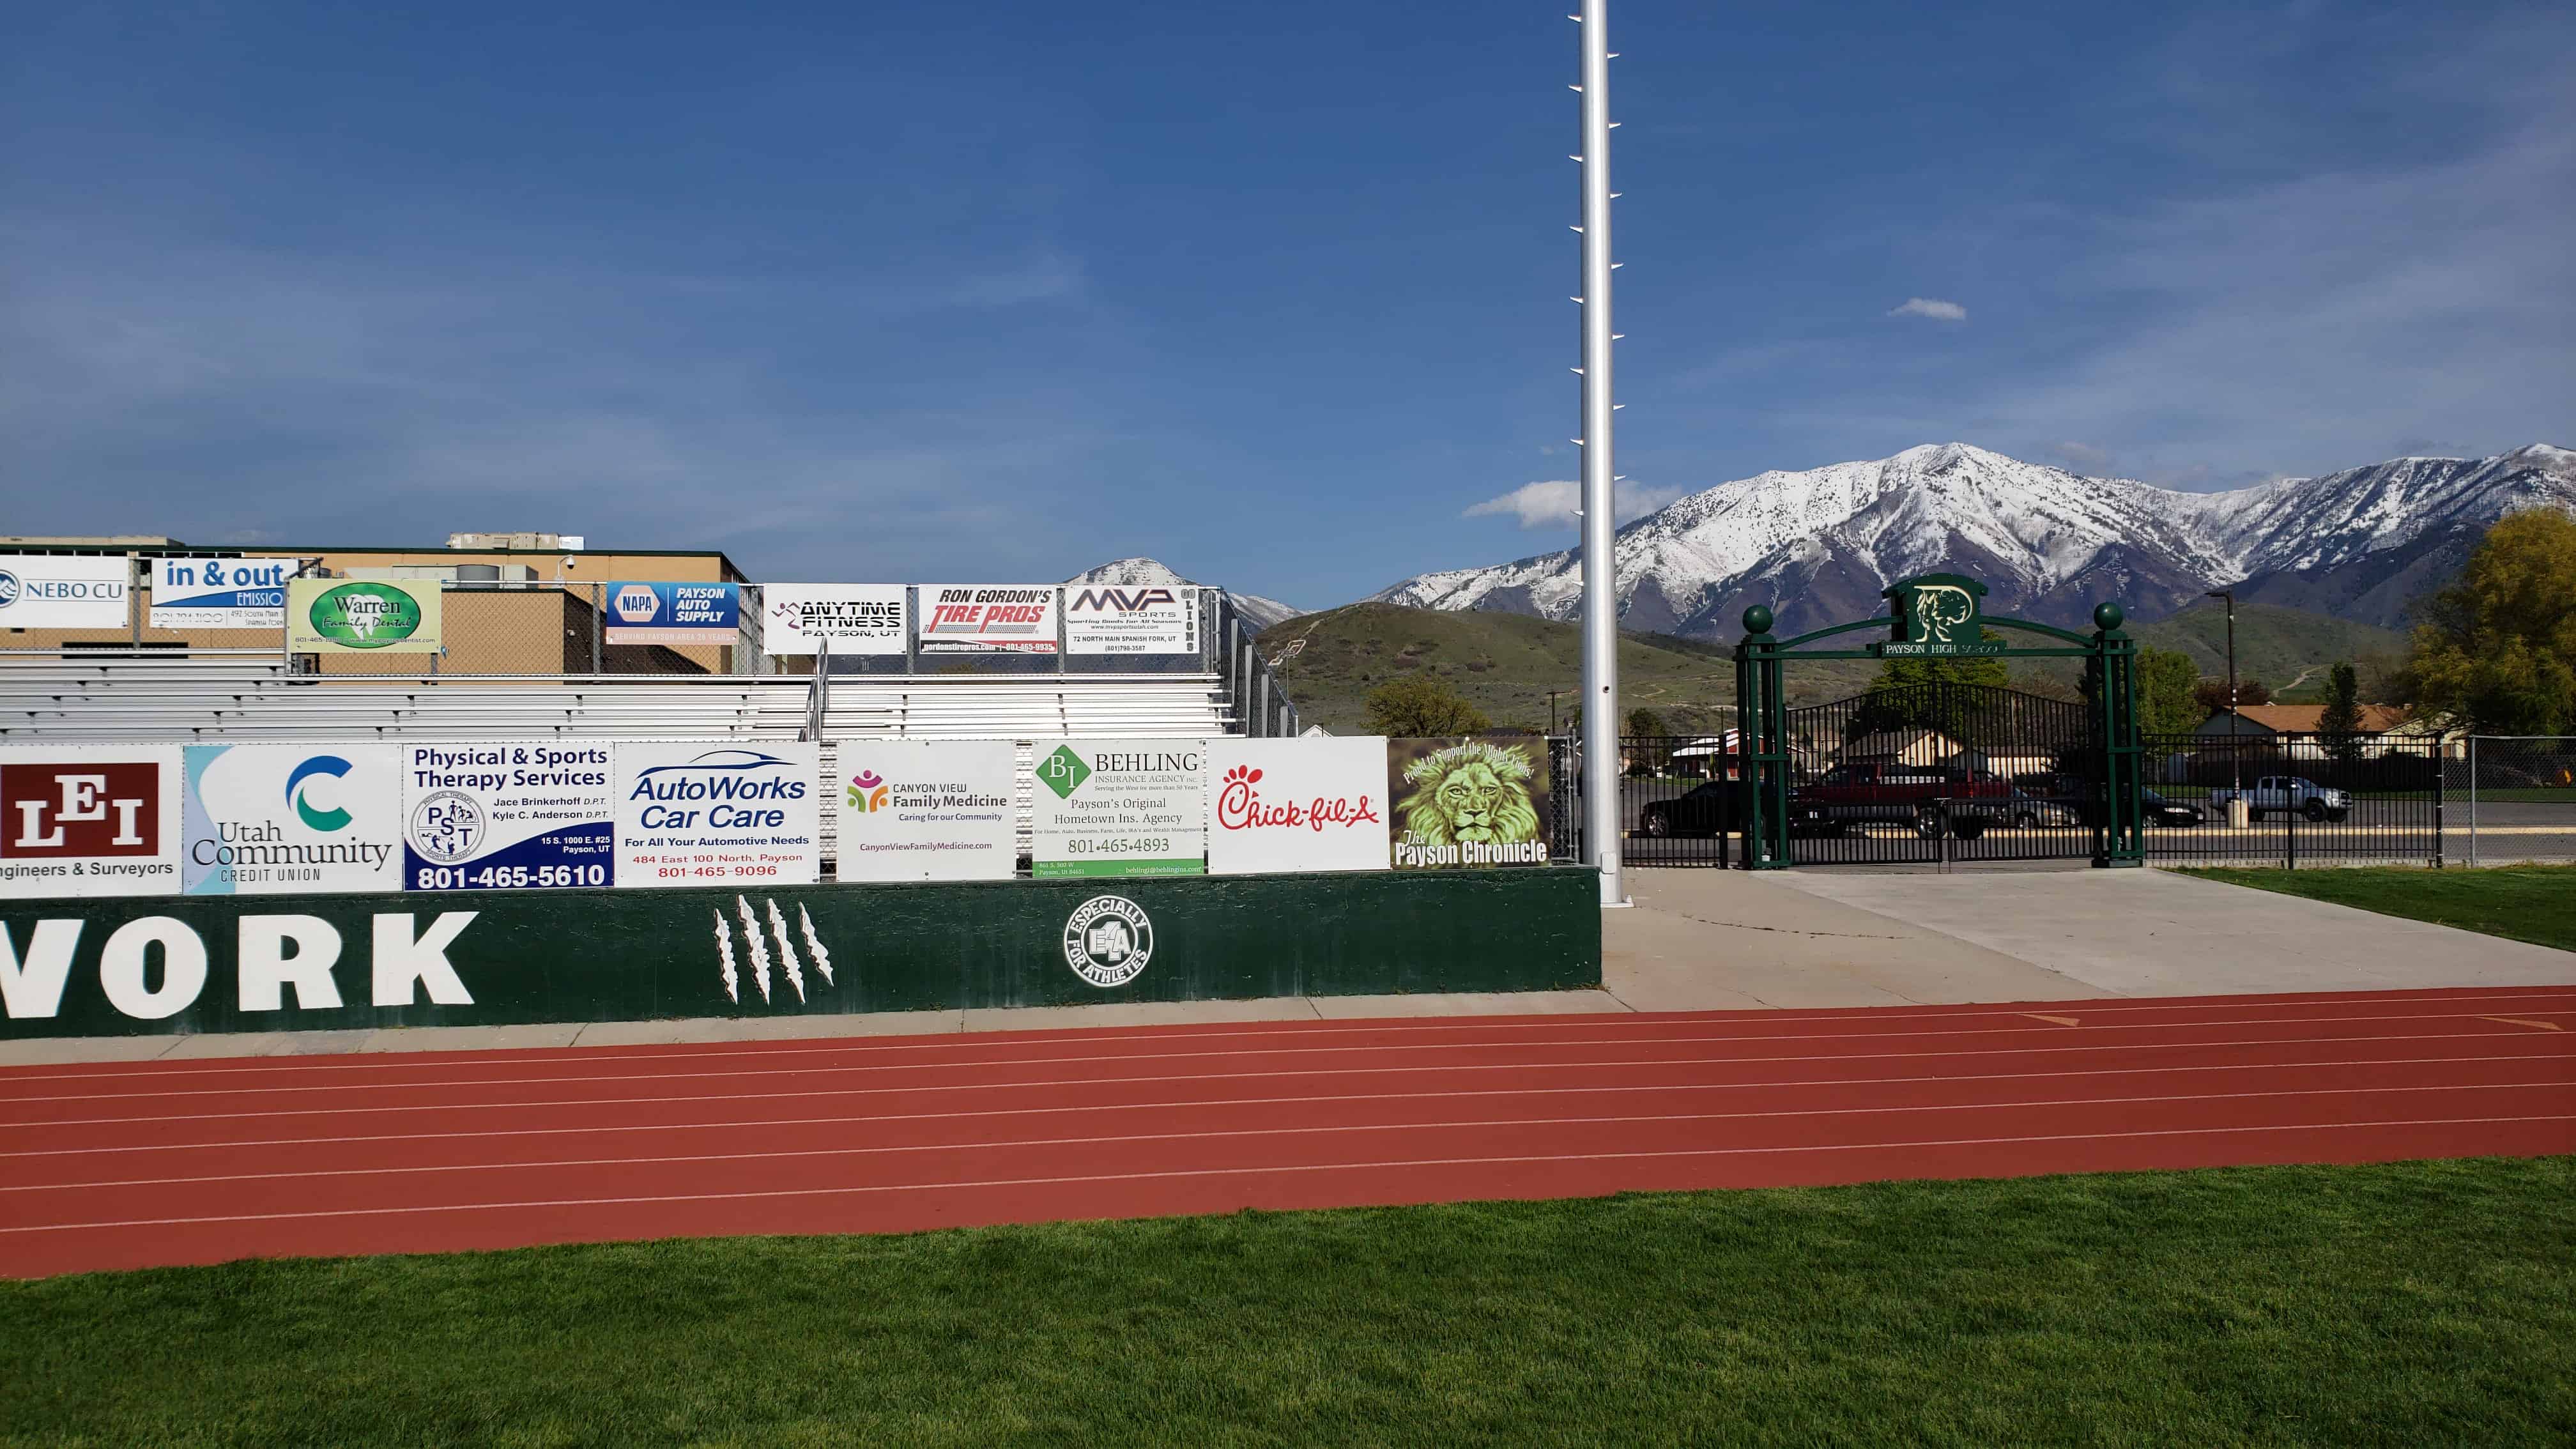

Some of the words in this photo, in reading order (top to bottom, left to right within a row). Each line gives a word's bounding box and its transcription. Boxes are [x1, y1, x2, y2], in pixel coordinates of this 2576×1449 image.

[167, 560, 194, 586] in
[203, 561, 226, 586] &
[233, 564, 284, 586] out
[26, 582, 88, 599] NEBO
[93, 583, 122, 599] CU
[676, 587, 726, 599] PAYSON
[939, 589, 973, 603] RON
[975, 590, 1052, 604] GORDON'S
[237, 592, 284, 606] EMISSIO
[333, 596, 401, 614] Warren
[622, 595, 653, 612] NAPA
[675, 599, 711, 611] AUTO
[1070, 588, 1176, 611] MVP
[800, 601, 901, 615] ANYTIME
[322, 616, 367, 631] Family
[371, 616, 411, 627] Dental
[676, 611, 724, 623] SUPPLY
[802, 616, 901, 628] FITNESS
[928, 605, 983, 634] TIRE
[977, 605, 1046, 634] PROS
[1885, 644, 1925, 654] PAYSON
[1931, 644, 1956, 654] HIGH
[415, 747, 506, 770] Physical
[512, 747, 528, 765] &
[535, 747, 608, 769] Sports
[1094, 753, 1199, 772] BEHLING
[1402, 757, 1427, 785] Proud
[1426, 755, 1436, 766] to
[1436, 744, 1466, 762] Support
[1469, 741, 1482, 755] the
[1483, 743, 1508, 763] Mighty
[414, 770, 508, 792] Therapy
[513, 768, 606, 787] Services
[1094, 775, 1147, 783] INSURANCE
[1149, 774, 1185, 783] AGENCY
[629, 776, 806, 801] AutoWorks
[893, 783, 936, 793] CANYON
[939, 783, 967, 793] VIEW
[493, 798, 518, 807] Jace
[521, 797, 581, 806] Brinkerhoff
[583, 797, 606, 806] D.P.T.
[893, 795, 940, 810] Family
[944, 794, 1007, 808] Medicine
[1071, 799, 1120, 811] Payson's
[1123, 798, 1166, 811] Original
[1218, 776, 1379, 832] Chick-fil-A
[15, 774, 144, 848] LEI
[492, 811, 516, 822] Kyle
[518, 811, 529, 820] C.
[532, 811, 583, 820] Anderson
[641, 805, 700, 829] Car
[709, 804, 785, 828] Care
[899, 813, 926, 822] Caring
[927, 813, 939, 821] for
[955, 813, 1002, 822] Community
[1055, 814, 1115, 824] Hometown
[1119, 813, 1138, 824] Ins.
[1142, 813, 1182, 825] Agency
[218, 820, 284, 843] Utah
[1403, 830, 1427, 847] The
[625, 838, 645, 847] For
[648, 838, 664, 847] All
[668, 838, 695, 847] Your
[698, 837, 767, 847] Automotive
[771, 836, 809, 845] Needs
[860, 842, 992, 853] CanyonViewFamilyMedicine.com
[192, 836, 393, 871] Community
[563, 846, 596, 855] Payson,
[598, 845, 611, 854] UT
[1395, 842, 1458, 868] Payson
[1462, 839, 1547, 864] Chronicle
[662, 855, 688, 864] East
[693, 855, 714, 863] 100
[760, 854, 802, 863] Payson
[72, 862, 84, 875] &
[90, 862, 174, 878] Surveyors
[220, 869, 271, 883] CREDIT
[277, 868, 321, 882] UNION
[417, 864, 605, 889] 801-465-5610
[659, 866, 777, 878] 801-465-9096
[1070, 899, 1147, 933] ESPECIALLY
[1068, 939, 1087, 969] FOR
[1082, 949, 1147, 983] ATHLETES
